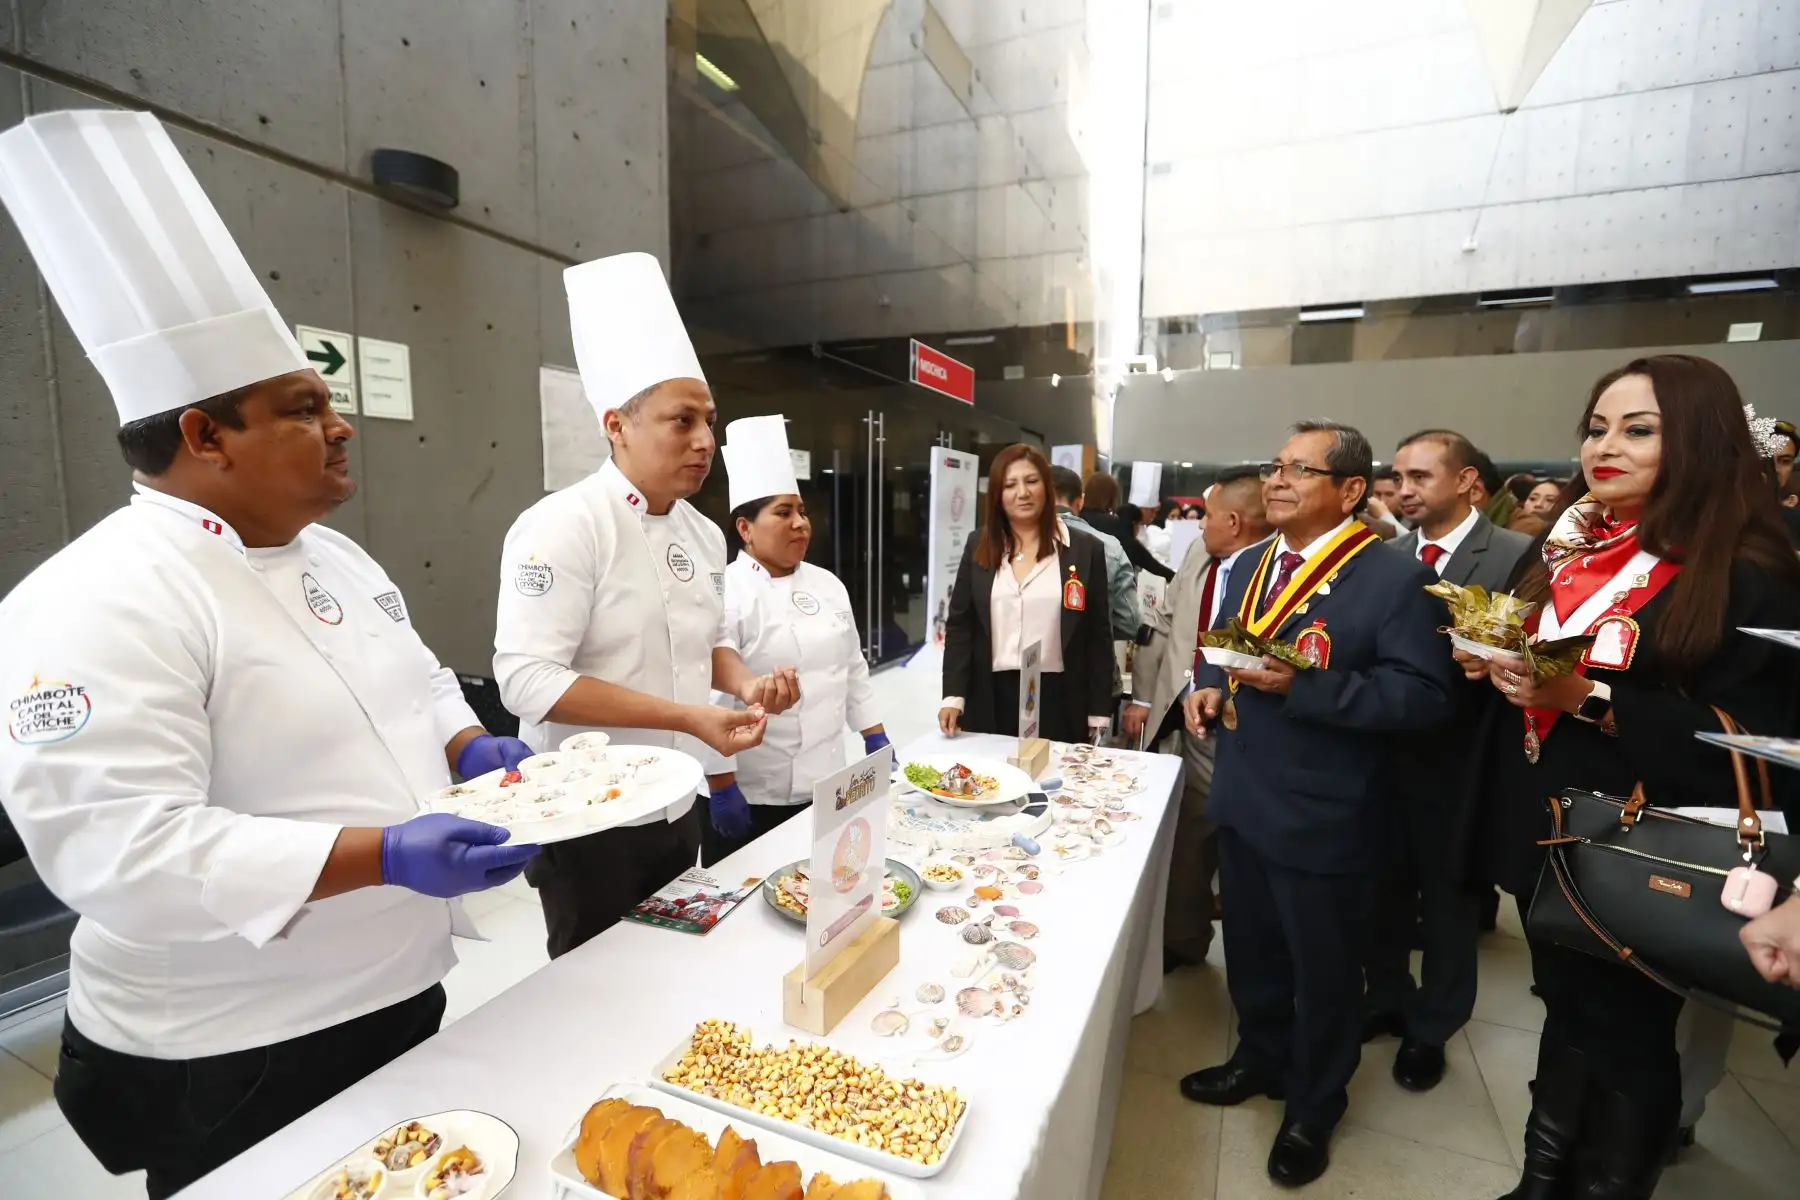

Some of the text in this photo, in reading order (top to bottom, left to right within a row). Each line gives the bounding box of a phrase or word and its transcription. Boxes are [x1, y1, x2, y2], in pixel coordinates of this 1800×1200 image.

[10, 686, 86, 711] CHIMBOTE
[18, 699, 75, 719] CAPITAL
[33, 711, 51, 720] DEL
[20, 716, 75, 736] CEVICHE
